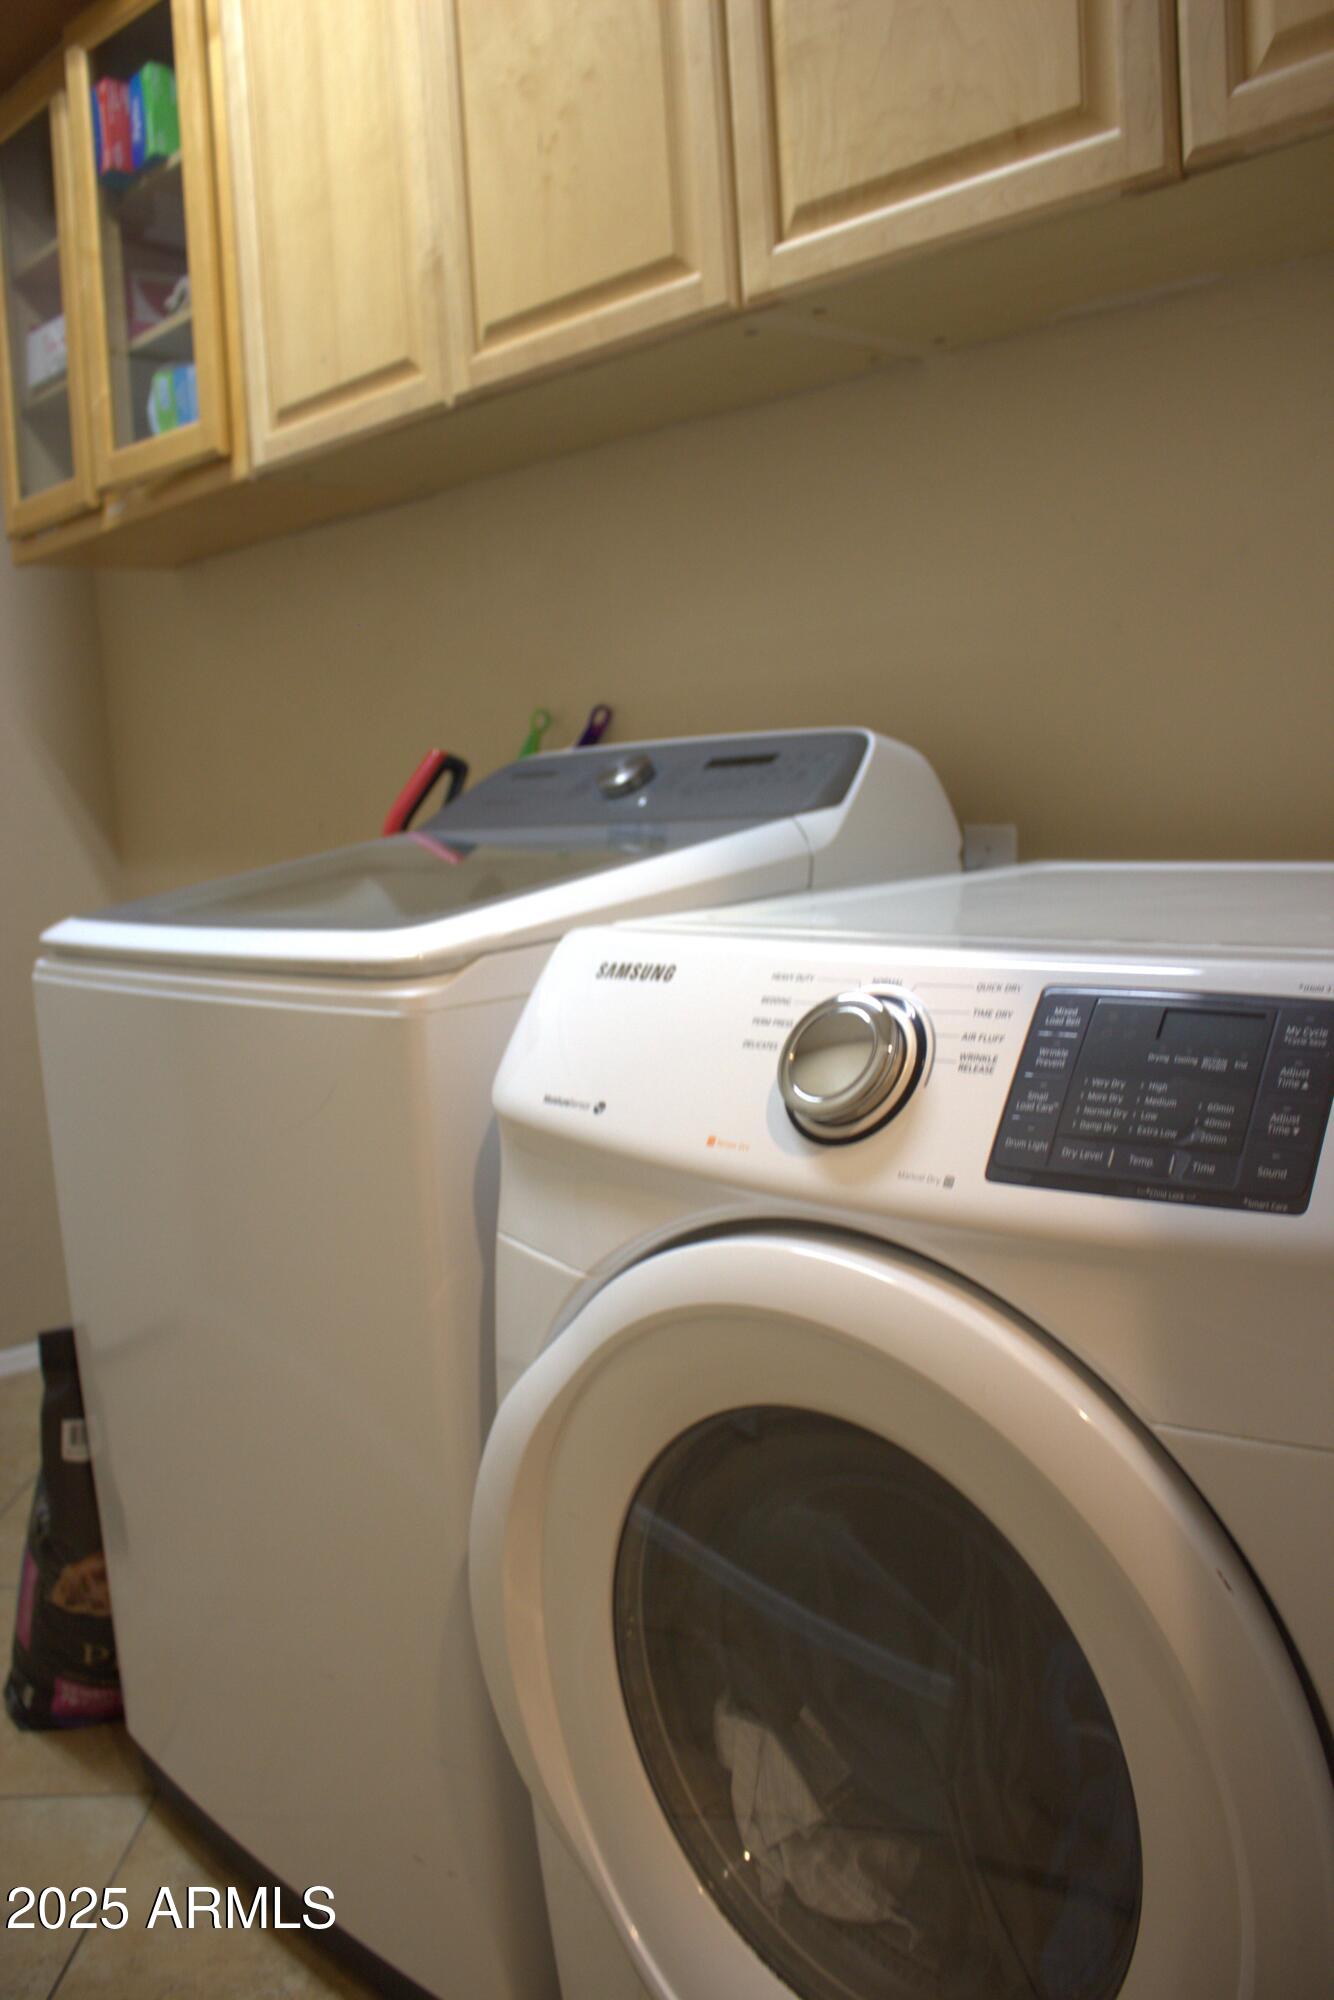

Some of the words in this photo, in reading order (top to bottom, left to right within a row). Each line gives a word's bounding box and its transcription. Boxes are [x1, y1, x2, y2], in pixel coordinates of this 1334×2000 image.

[596, 961, 677, 983] SAMSUNG
[976, 982, 1003, 993] QUICK
[1004, 983, 1023, 993] DRY
[973, 1007, 993, 1018] TIME
[995, 1009, 1014, 1019] DRY
[1054, 1006, 1079, 1016] Mixed
[1044, 1015, 1065, 1026] Load
[961, 1032, 977, 1042] AIR
[977, 1033, 1006, 1044] FLUFF
[1285, 1024, 1302, 1037] My
[1302, 1025, 1329, 1040] Cycle
[959, 1053, 999, 1064] WRINKLE
[1039, 1047, 1069, 1058] Wrinkle
[957, 1063, 996, 1074] RELEASE
[1035, 1057, 1066, 1069] Prevent
[1280, 1067, 1310, 1080] Adjust
[1092, 1077, 1110, 1089] Very
[1111, 1078, 1127, 1090] Dry
[1148, 1081, 1168, 1093] High
[1278, 1077, 1301, 1090] Time
[1027, 1090, 1049, 1102] Small
[1087, 1091, 1108, 1102] More
[1109, 1092, 1124, 1104] Dry
[1144, 1095, 1177, 1107] Medium
[1016, 1101, 1035, 1112] Load
[1083, 1105, 1112, 1117] Normal
[1113, 1108, 1129, 1120] Dry
[1140, 1110, 1159, 1121] Low
[1271, 1112, 1301, 1125] Adjust
[1079, 1119, 1103, 1132] Damp
[1103, 1121, 1118, 1134] Dry
[1137, 1124, 1159, 1137] Extra
[1159, 1126, 1178, 1139] Low
[1268, 1122, 1291, 1136] Time
[1005, 1137, 1027, 1150] Drum
[1027, 1139, 1048, 1152] Light
[1061, 1146, 1079, 1160] Dry
[1079, 1148, 1104, 1161] Level
[1193, 1161, 1216, 1175] Time
[1257, 1165, 1288, 1180] Sound
